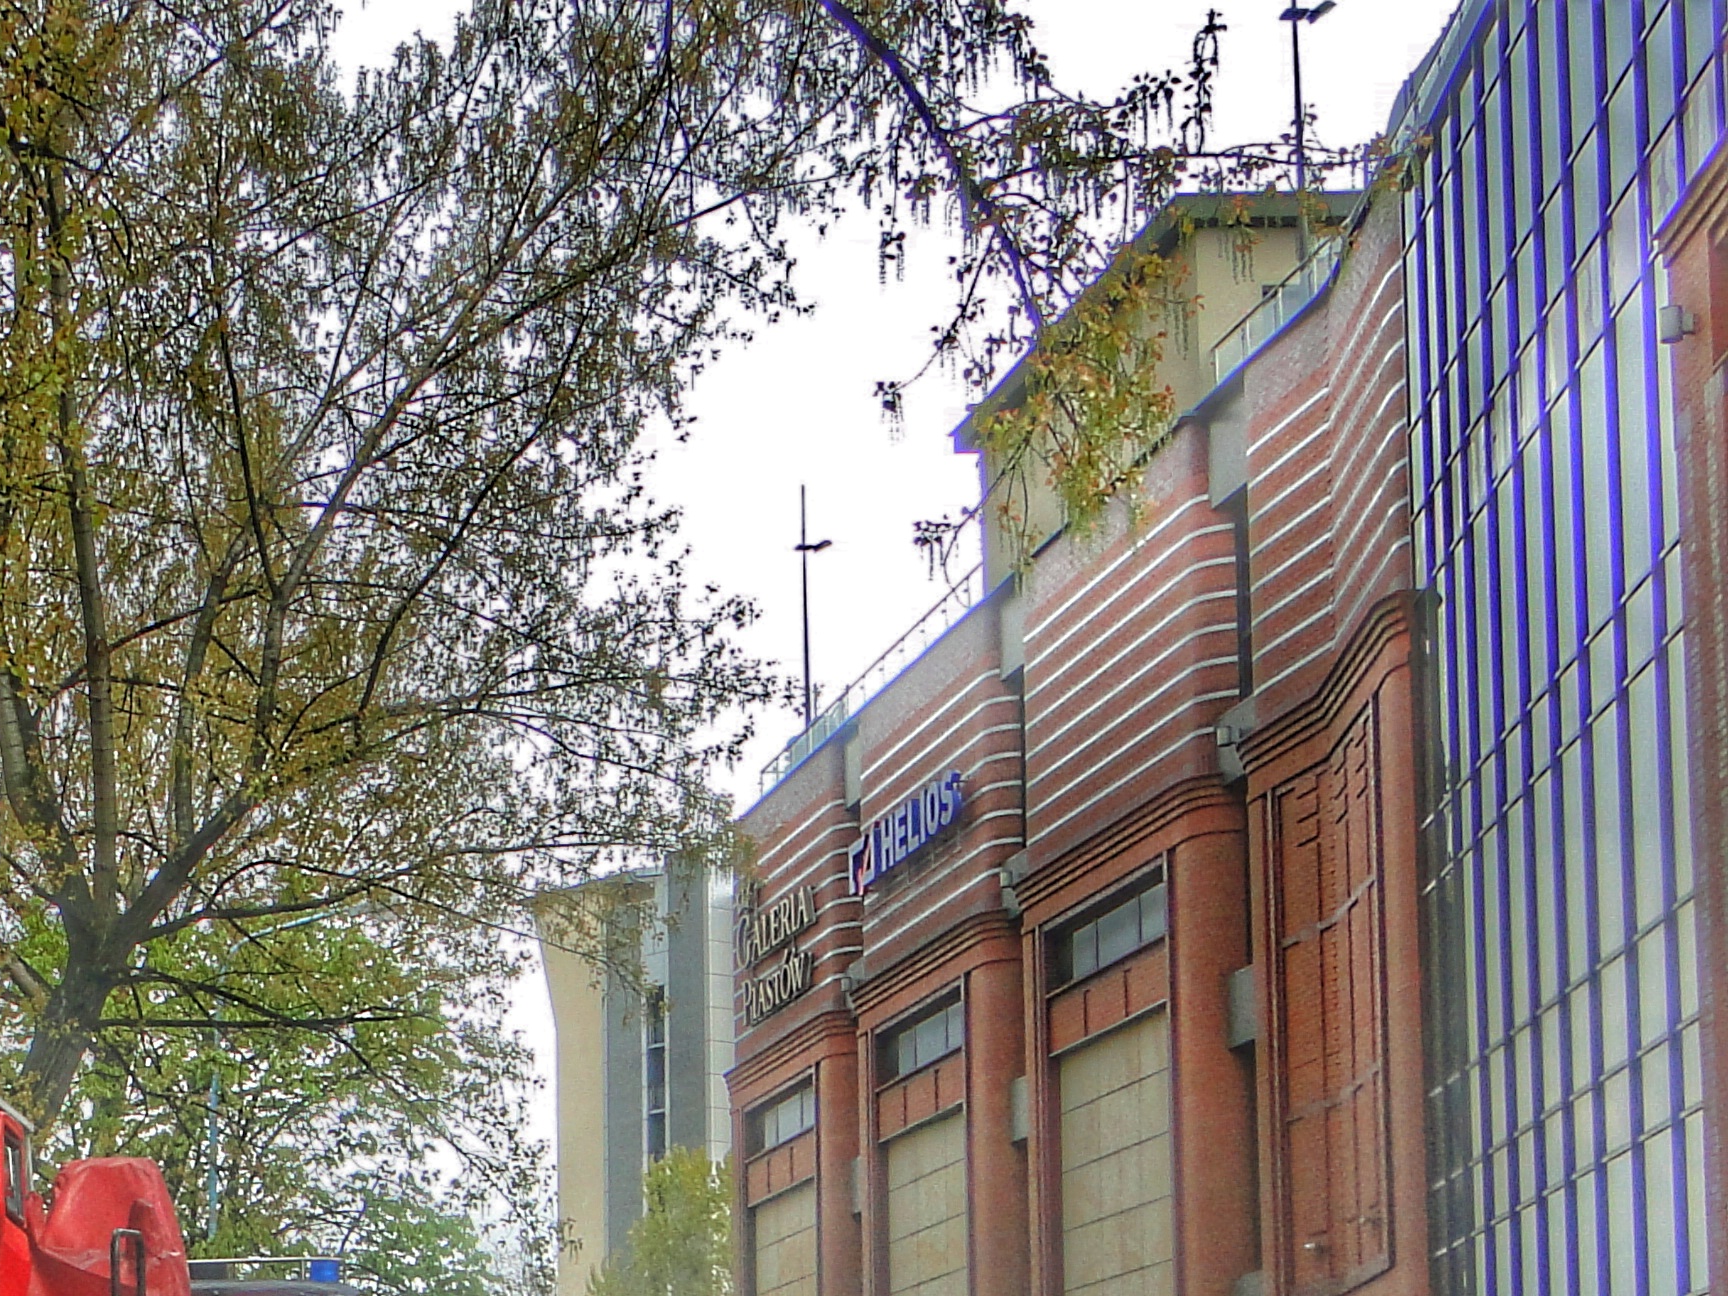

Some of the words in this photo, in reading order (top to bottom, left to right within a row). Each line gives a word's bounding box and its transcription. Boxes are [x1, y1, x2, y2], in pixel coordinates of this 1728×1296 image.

[879, 769, 962, 873] HELIOS
[736, 885, 814, 970] GALERIA
[742, 947, 810, 1027] PIASTÓW
